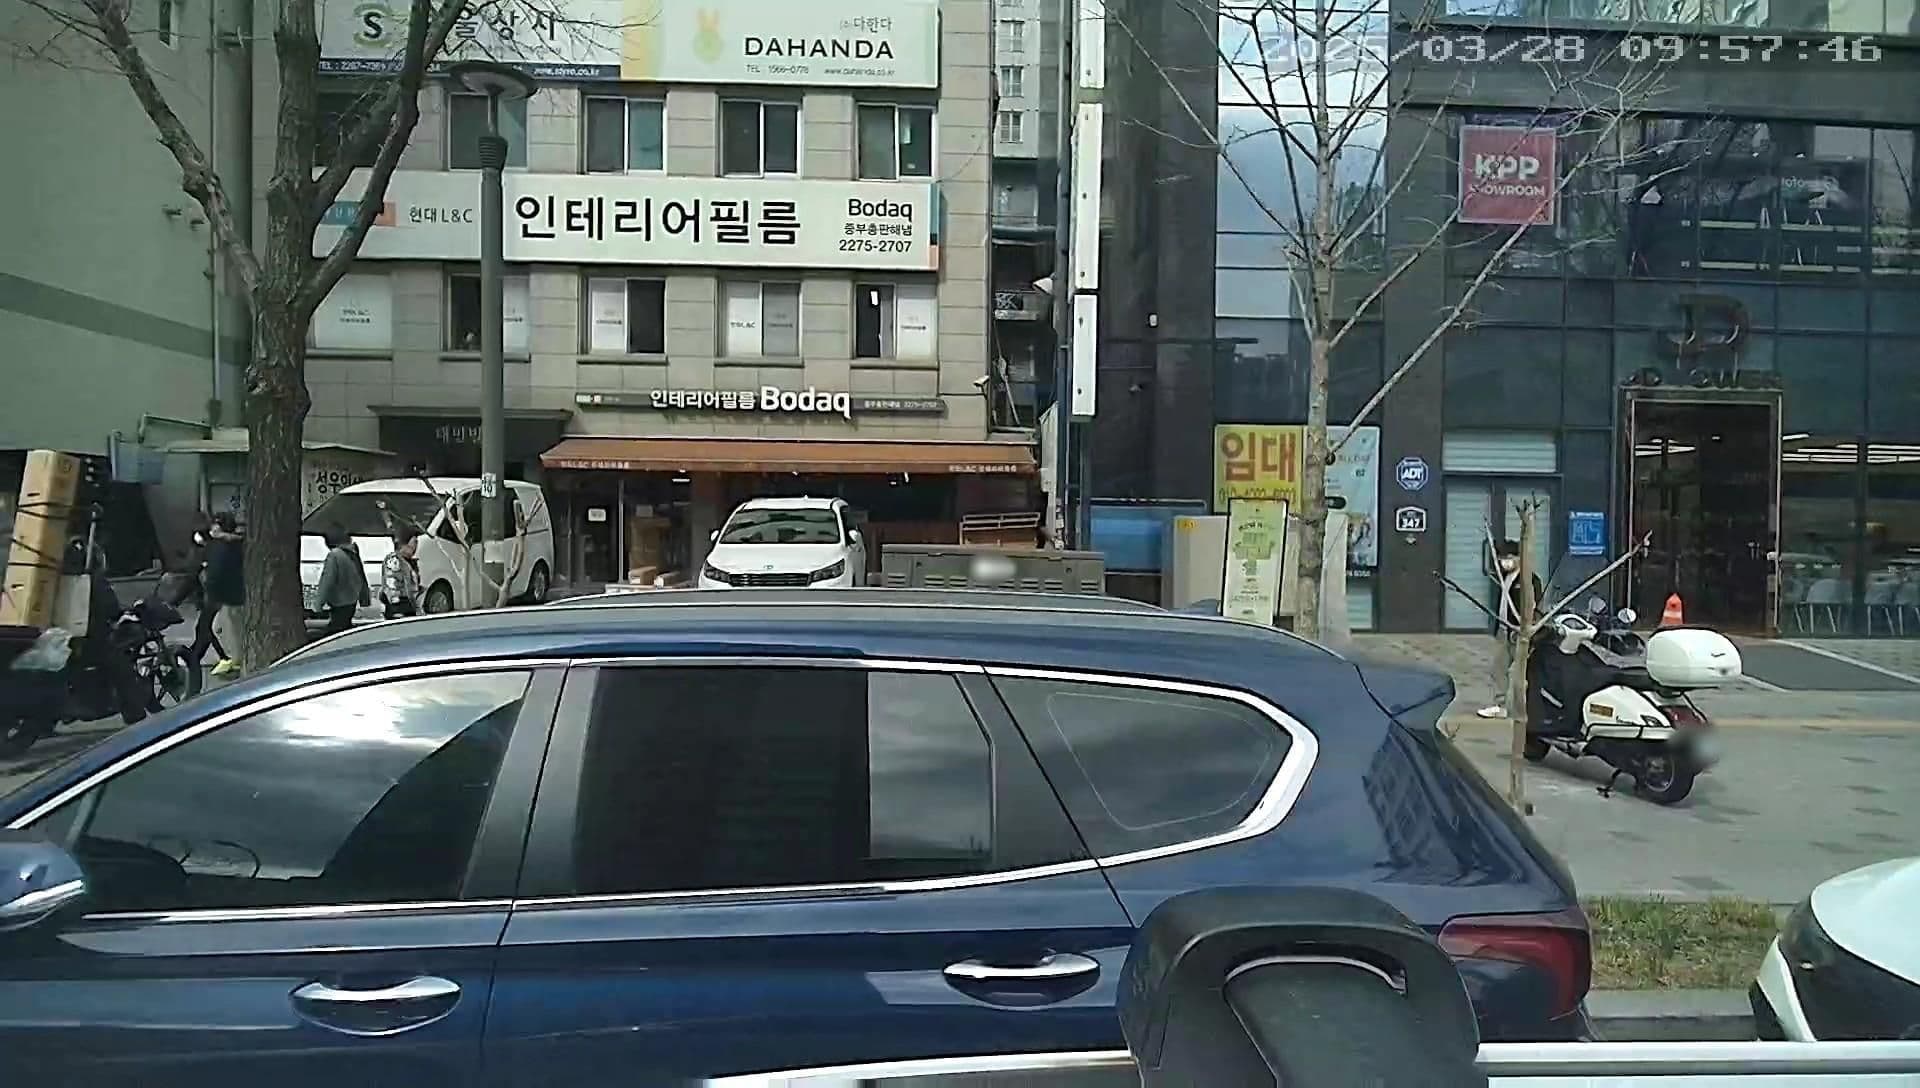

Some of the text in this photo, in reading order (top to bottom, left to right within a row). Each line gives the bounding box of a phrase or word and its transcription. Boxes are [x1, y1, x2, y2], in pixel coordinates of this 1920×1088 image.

[853, 15, 893, 33] 다한다
[744, 37, 894, 60] DAHANDA
[746, 64, 761, 73] TEL
[1475, 153, 1540, 180] KPP
[515, 195, 801, 245] 인테리어필름
[847, 198, 913, 223] Bodaq
[839, 238, 913, 253] 2275-2707
[650, 386, 852, 420] 인테리어필름 Bodaq
[1220, 431, 1296, 483] 임대
[1400, 466, 1424, 481] ADT
[1401, 516, 1421, 529] 347
